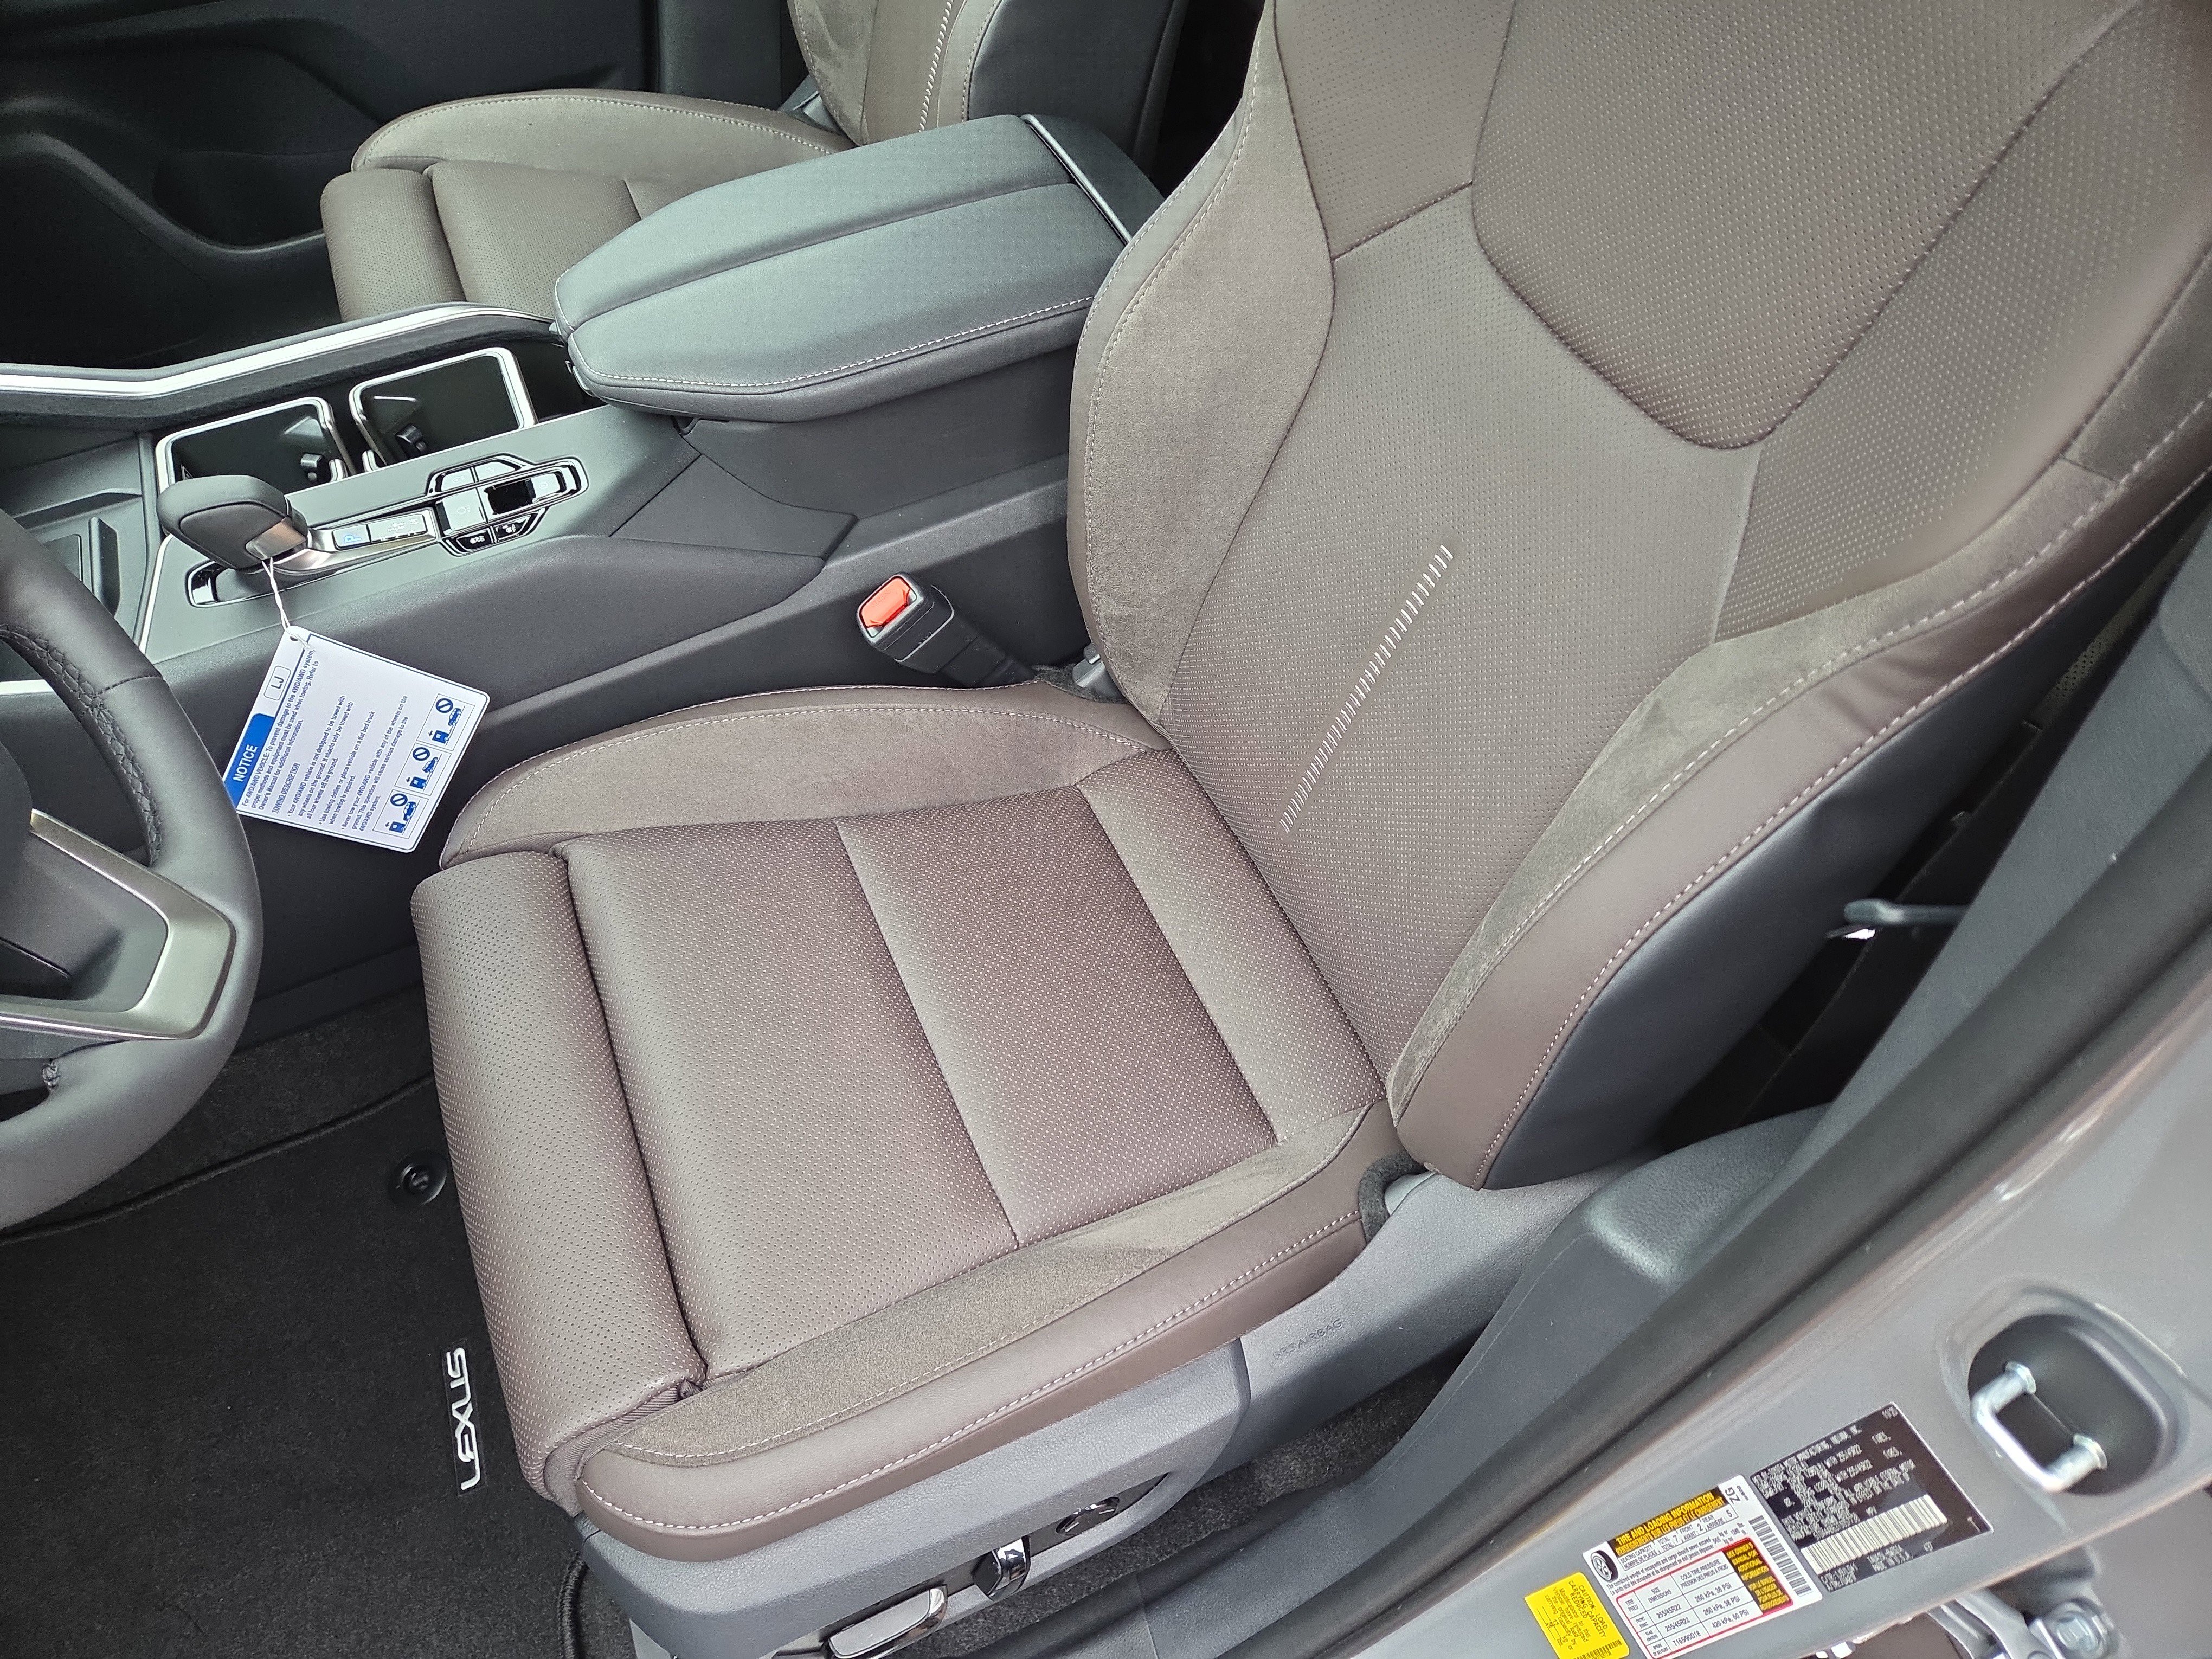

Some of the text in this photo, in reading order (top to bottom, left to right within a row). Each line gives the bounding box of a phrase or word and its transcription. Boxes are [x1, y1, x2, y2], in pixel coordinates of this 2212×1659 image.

[344, 534, 363, 542] P
[301, 648, 317, 669] system,
[306, 666, 317, 680] Refer
[269, 675, 285, 690] LJ
[290, 668, 306, 694] 4WD/AWD
[298, 679, 312, 698] towing.
[286, 693, 295, 702] the
[292, 698, 303, 711] when
[336, 695, 346, 705] with
[399, 695, 408, 703] the
[330, 705, 341, 720] towed
[344, 701, 353, 712] with
[276, 708, 291, 727] damage
[287, 710, 297, 723] used
[338, 711, 349, 725] towed
[364, 710, 375, 723] truck
[389, 710, 401, 726] wheels
[279, 729, 289, 741] must
[361, 723, 369, 732] bed
[385, 726, 393, 734] the
[268, 726, 282, 745] prevent
[314, 731, 331, 753] designed
[330, 732, 341, 743] only
[357, 732, 365, 740] flat
[323, 742, 335, 758] should
[380, 740, 388, 749] any
[268, 741, 285, 766] equipment
[311, 752, 320, 761] not
[345, 750, 357, 766] vehicle
[374, 748, 383, 758] with
[232, 743, 259, 782] NOTICE
[255, 751, 270, 775] VEHICLE:
[265, 765, 273, 774] and
[314, 761, 327, 779] ground.
[366, 758, 378, 774] vehicle
[258, 792, 271, 810] Owner's
[266, 775, 278, 792] Manual
[276, 745, 291, 768] additional
[301, 766, 314, 782] vehicle
[339, 766, 351, 779] place
[350, 813, 364, 830] ground.
[358, 804, 366, 814] This
[362, 783, 377, 805] operation
[372, 776, 380, 784] will
[377, 763, 386, 776] cause
[382, 746, 394, 763] serious
[389, 729, 403, 747] damage
[400, 716, 408, 724] the
[245, 775, 260, 798] 4WD/AWD
[256, 774, 269, 793] methods
[271, 762, 300, 814] TOWING DESCRIPTION
[310, 779, 318, 787] the
[356, 774, 371, 796] 4WD/AWD
[292, 781, 307, 804] 4WD/AWD
[330, 783, 341, 799] dollies
[241, 798, 250, 806] For
[251, 793, 262, 808] proper
[300, 793, 312, 808] wheels
[323, 798, 336, 813] towing
[327, 812, 338, 824] when
[333, 798, 346, 813] towing
[342, 774, 357, 794] required.
[352, 796, 362, 807] your
[287, 803, 297, 814] Your
[298, 808, 306, 817] any
[347, 806, 356, 815] tow
[319, 813, 327, 822] Use
[341, 814, 352, 827] Never
[1298, 1318, 1343, 1348] AIRBAG
[446, 1346, 482, 1491] LEXUS
[1693, 1496, 1726, 1517] CHARGEMENT
[1725, 1509, 1733, 1518] 5
[1615, 1532, 1632, 1546] TIRE
[1629, 1525, 1646, 1539] AND
[1642, 1512, 1674, 1532] LOADING
[1669, 1491, 1715, 1519] INFORMATION
[1695, 1522, 1703, 1532] 2
[1672, 1534, 1680, 1543] 7
[1634, 1544, 1654, 1557] CAPACITY
[1703, 1588, 1717, 1599] kPa,
[1714, 1585, 1723, 1594] 38
[1720, 1581, 1732, 1591] PSI
[1568, 1579, 1588, 1609] CARRYING
[1586, 1610, 1606, 1639] CAPACITY
[1569, 1591, 1588, 1619] REDUCED
[1711, 1602, 1726, 1612] kPa,
[1729, 1594, 1741, 1604] PSI
[1655, 1603, 1682, 1619] 255/45R22
[1710, 1619, 1722, 1629] 420
[1720, 1615, 1734, 1626] kPa,
[1738, 1608, 1750, 1617] PSI
[1596, 1612, 1608, 1630] LOAD
[1663, 1616, 1690, 1632] 255/45R22
